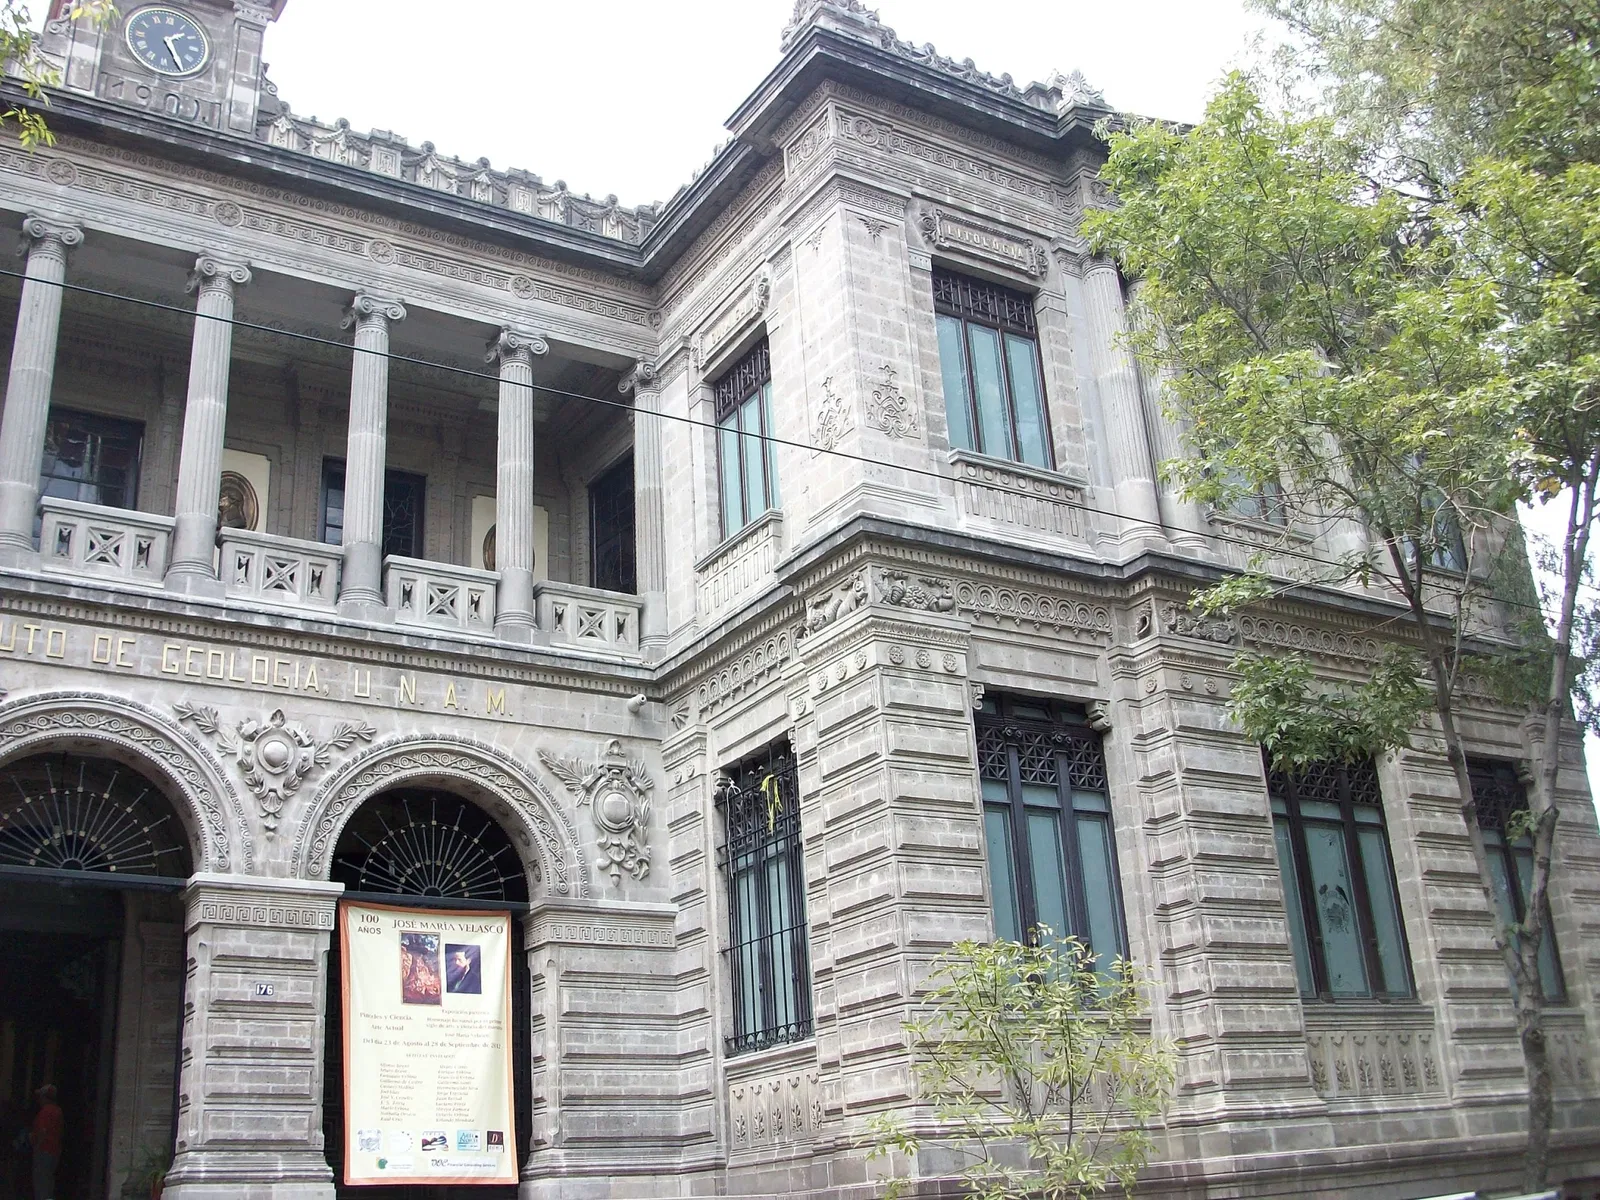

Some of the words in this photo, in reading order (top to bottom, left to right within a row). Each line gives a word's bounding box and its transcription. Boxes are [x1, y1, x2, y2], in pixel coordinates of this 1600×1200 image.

[92, 632, 136, 668] DE
[161, 643, 330, 697] GEOLOGIA,
[360, 913, 380, 924] 100
[357, 926, 382, 935] AÑOS
[392, 918, 417, 929] JOSÉ
[420, 920, 455, 931] MARÍA
[458, 923, 504, 934] VELASCO
[256, 984, 274, 996] 176
